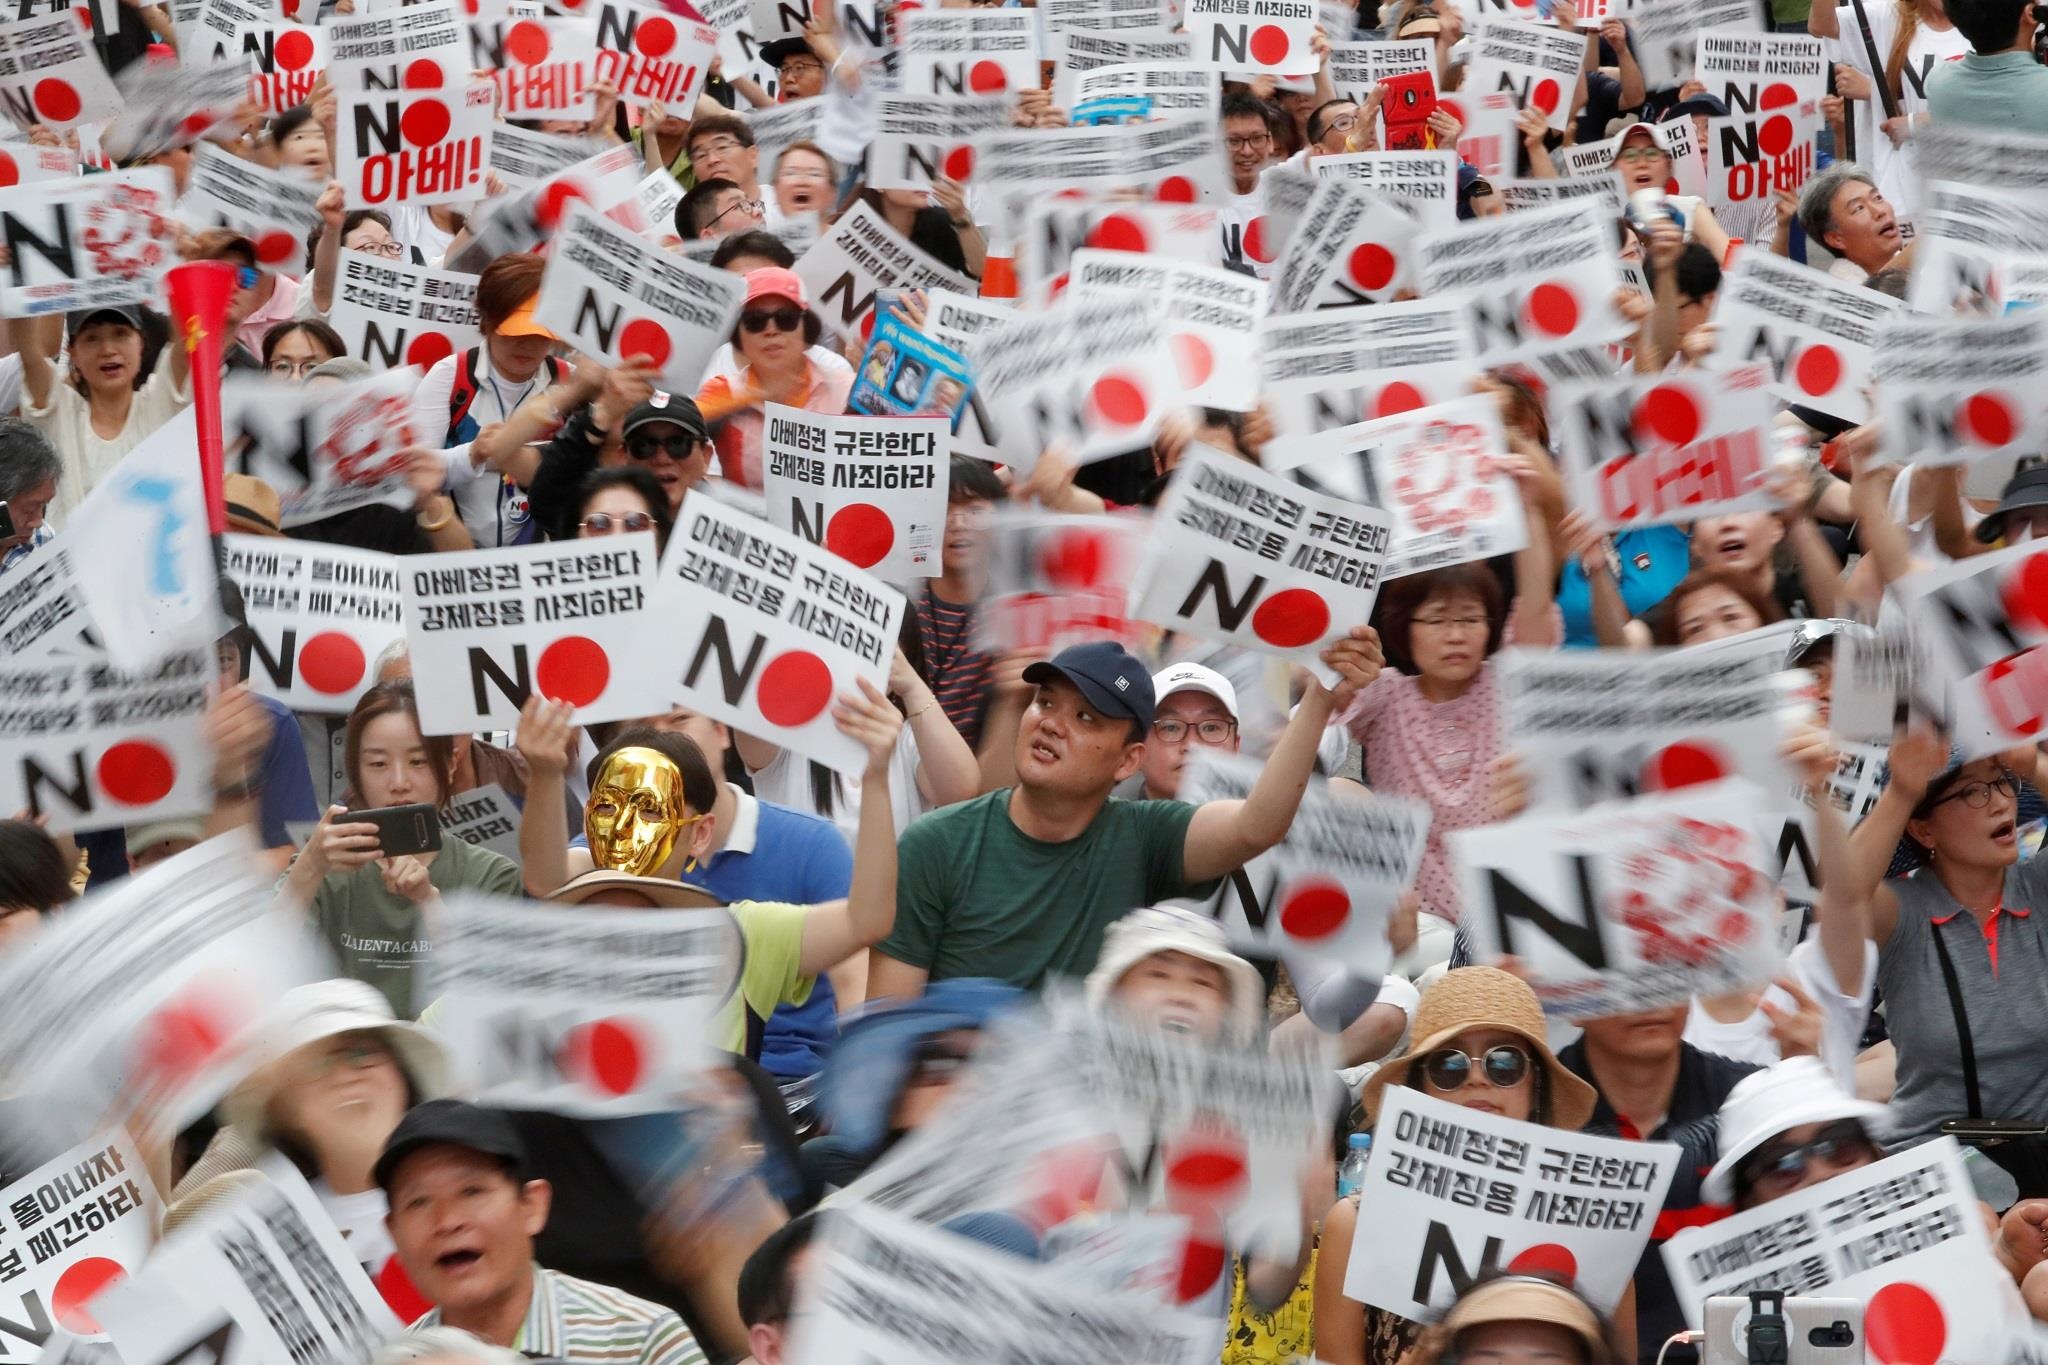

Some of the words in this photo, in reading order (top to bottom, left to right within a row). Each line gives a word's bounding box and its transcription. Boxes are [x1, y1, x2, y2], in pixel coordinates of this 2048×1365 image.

[597, 4, 677, 56] NO
[1254, 0, 1313, 20] 사죄하라
[243, 31, 315, 74] NO
[360, 58, 445, 91] NO
[1211, 23, 1290, 66] NO
[931, 59, 1007, 96] NO
[1498, 71, 1560, 116] NO
[1724, 81, 1799, 115] NO
[354, 98, 452, 159] NO
[1720, 114, 1794, 168] NO
[362, 136, 481, 204] 아베!
[362, 320, 454, 374] NO
[572, 286, 672, 373] NO
[770, 417, 826, 454] 아베정권
[833, 430, 936, 457] 규탄한다
[769, 450, 825, 486] 강제징용
[832, 463, 936, 489] 사죄하라
[791, 496, 895, 569] NO
[414, 562, 523, 597] 아베정권
[529, 549, 641, 588] 규탄한다
[690, 513, 798, 582] 아베정권
[801, 561, 891, 632] 규탄한다
[1177, 557, 1331, 648] NO
[418, 599, 525, 632] 강제징용
[534, 585, 646, 623] 사죄하라
[678, 548, 785, 617] 강제징용
[788, 597, 884, 667] 사죄하라
[240, 626, 366, 699] NO
[466, 635, 610, 716] NO
[682, 613, 833, 728] NO
[21, 740, 176, 817] NO
[1394, 1108, 1532, 1178] 아베정권
[1537, 1145, 1660, 1194] 규탄한다
[9, 1144, 126, 1232] 몰아내자
[1385, 1150, 1521, 1219] 강제징용
[1523, 1189, 1646, 1233] 사죄하라
[26, 1178, 145, 1266] 폐간하라
